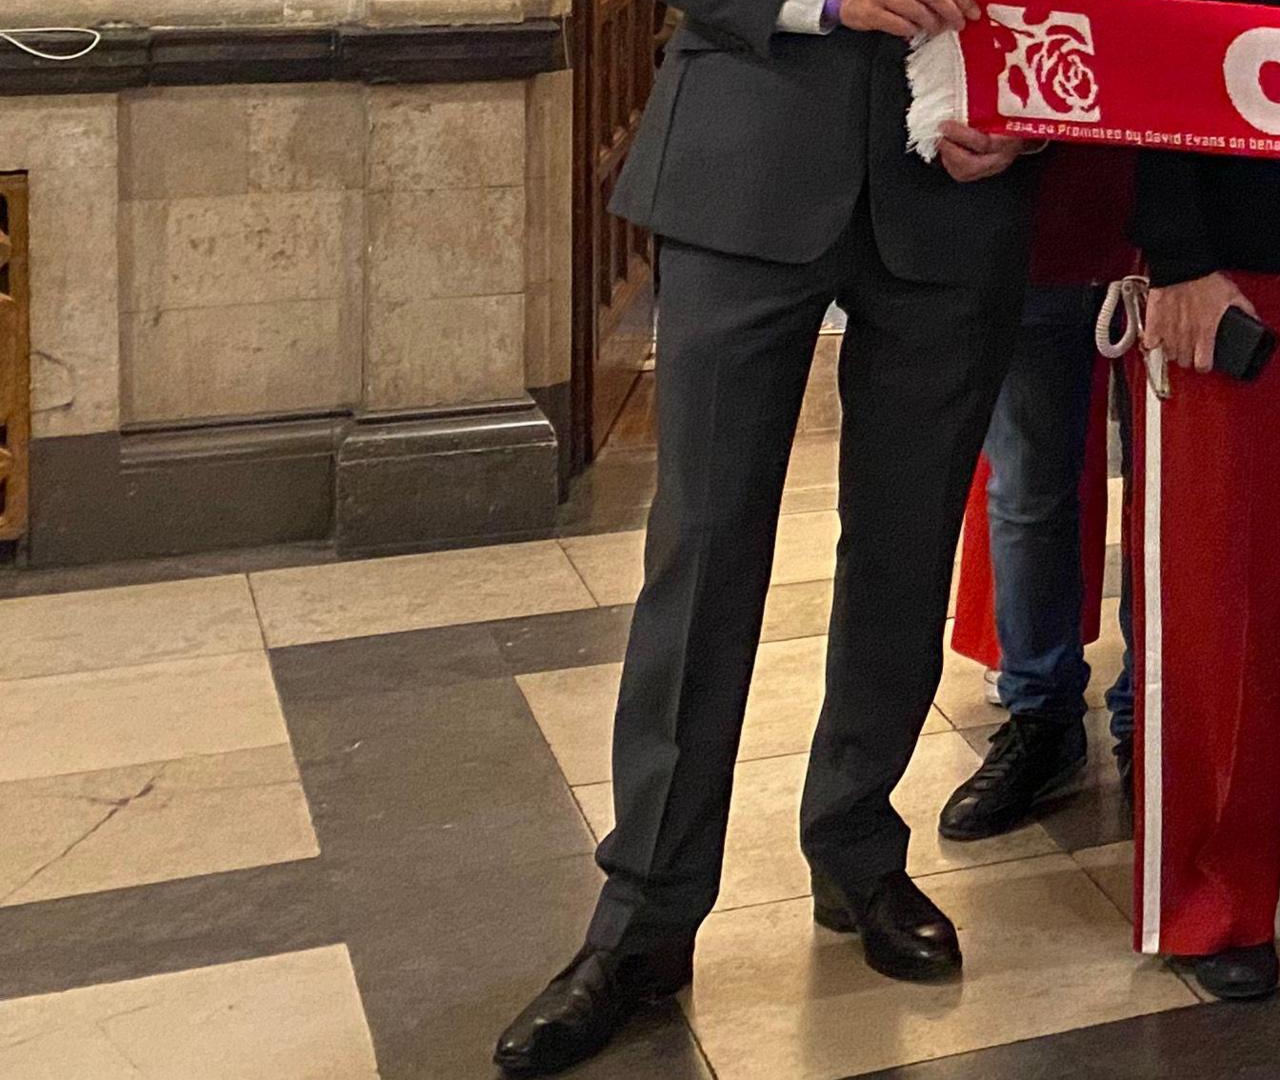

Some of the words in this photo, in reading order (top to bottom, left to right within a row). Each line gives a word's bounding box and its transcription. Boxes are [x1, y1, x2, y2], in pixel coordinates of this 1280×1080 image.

[1057, 126, 1121, 140] Promoted
[1125, 129, 1142, 145] by
[1145, 130, 1181, 145] David
[1185, 133, 1226, 147] Evans
[1230, 136, 1245, 149] on
